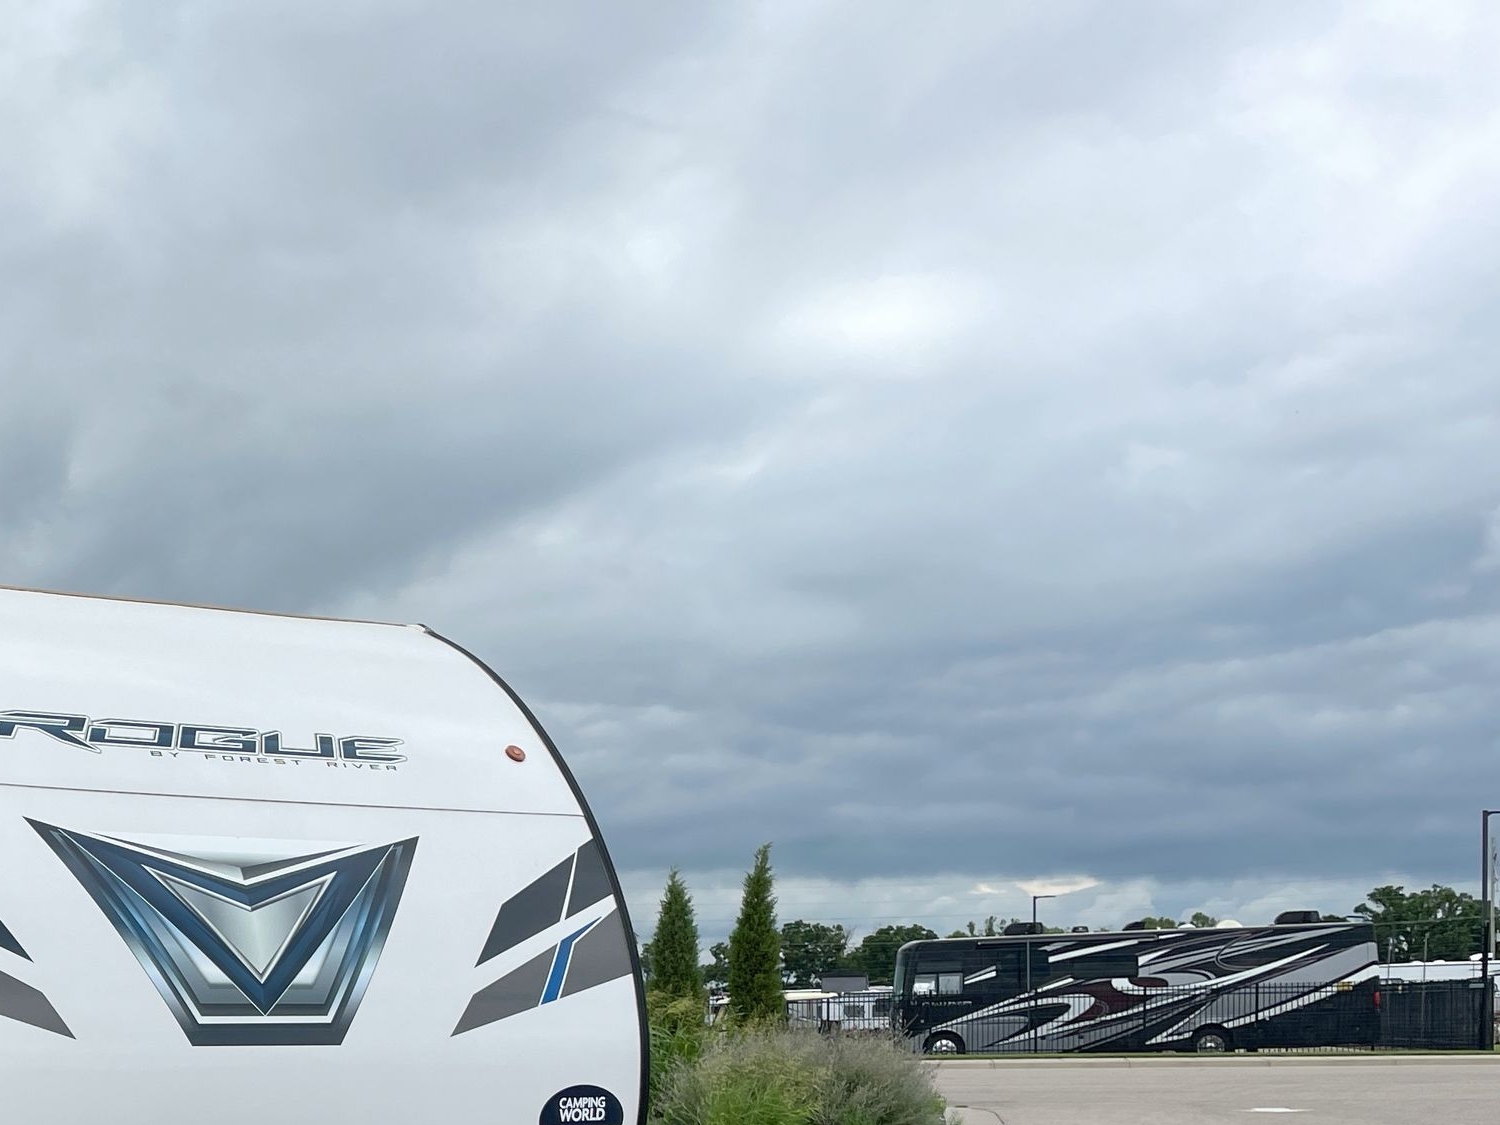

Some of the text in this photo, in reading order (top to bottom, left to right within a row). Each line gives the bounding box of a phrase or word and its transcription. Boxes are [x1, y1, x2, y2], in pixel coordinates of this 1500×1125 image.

[150, 750, 398, 771] BY FOREST RIVER
[559, 1096, 606, 1109] CAMPING
[559, 1108, 606, 1122] WORLD
